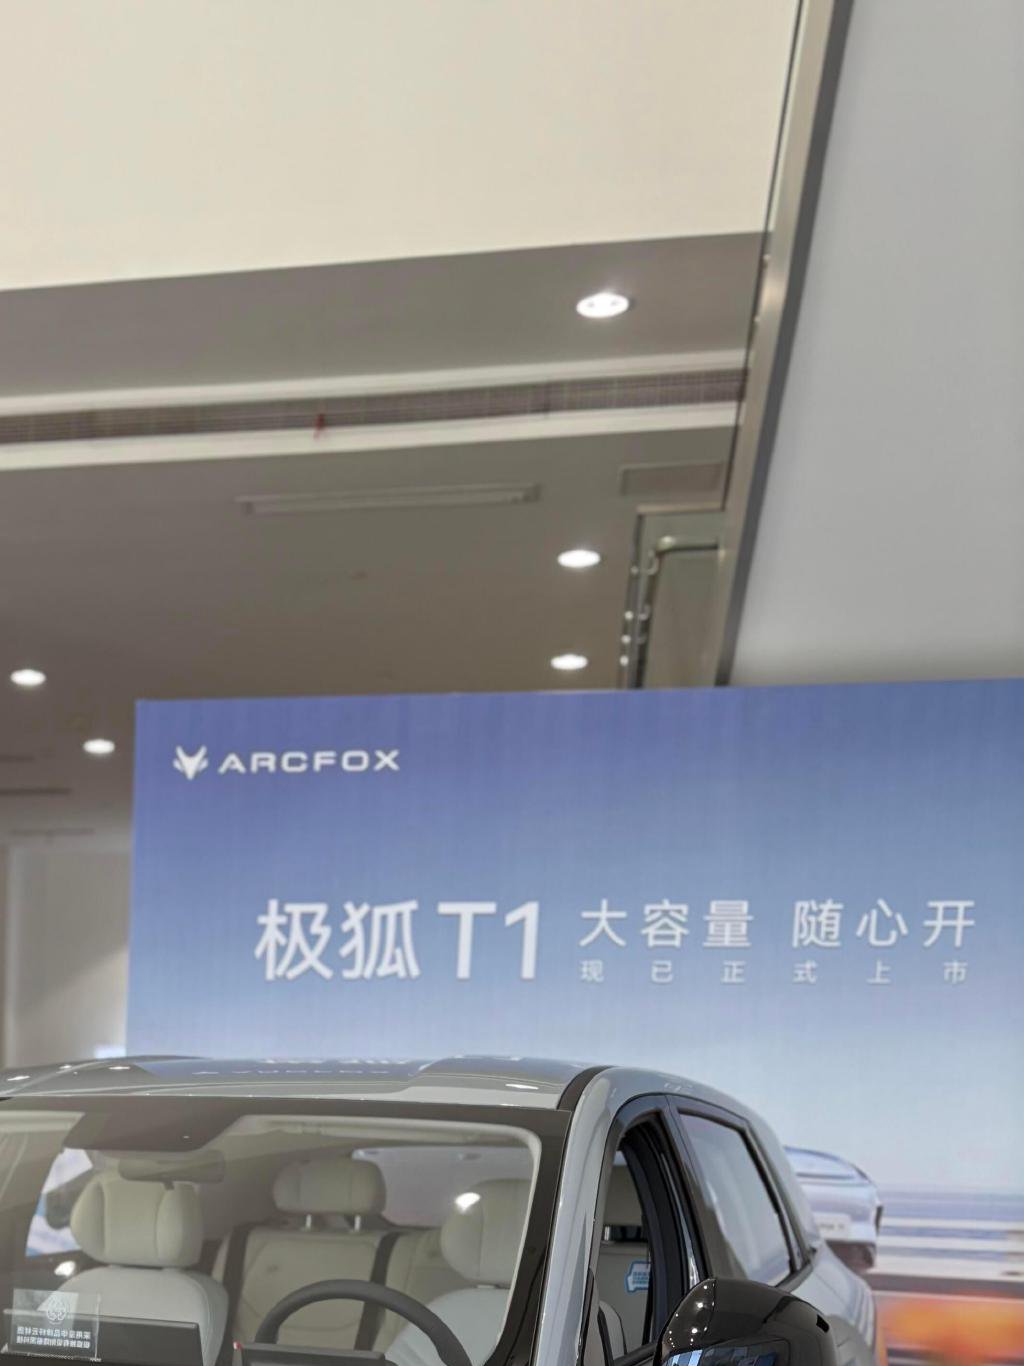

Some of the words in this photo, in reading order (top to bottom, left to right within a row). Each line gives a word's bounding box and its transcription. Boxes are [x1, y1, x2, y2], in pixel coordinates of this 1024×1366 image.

[218, 747, 401, 774] ARCFOX
[579, 898, 754, 948] 大容量
[791, 898, 976, 949] 随心开
